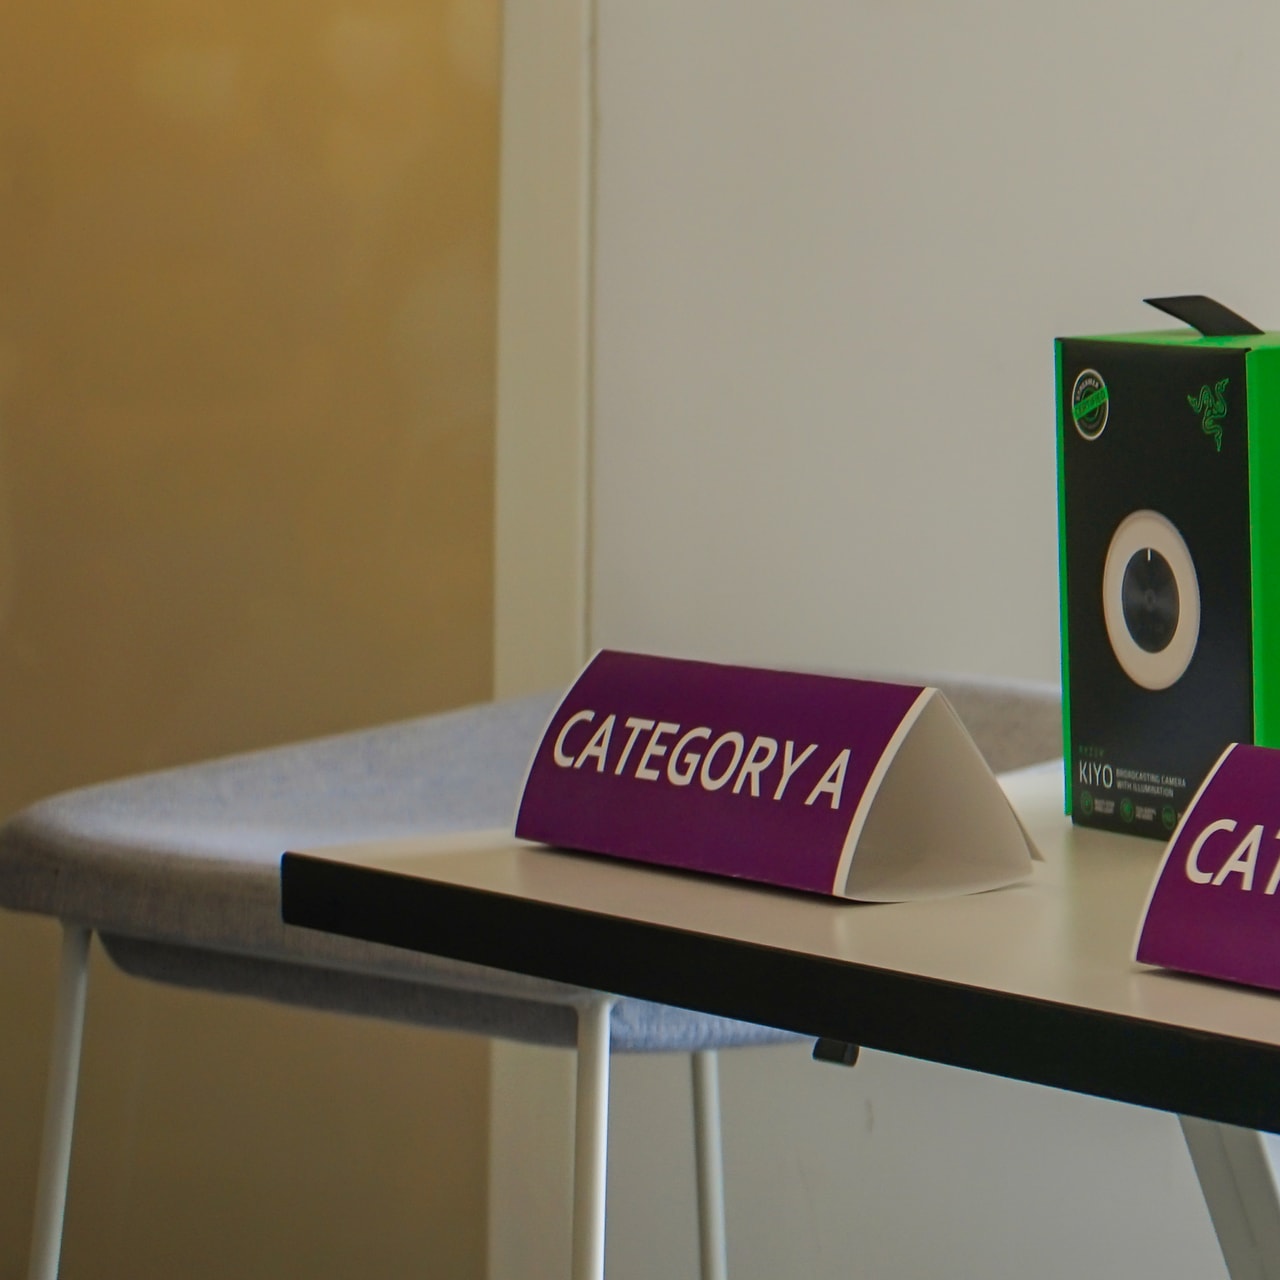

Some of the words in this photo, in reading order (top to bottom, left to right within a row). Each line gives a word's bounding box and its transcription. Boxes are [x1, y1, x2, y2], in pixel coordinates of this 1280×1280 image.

[552, 708, 818, 801] CATEGORY
[804, 748, 852, 810] A
[1079, 759, 1113, 790] KIYO
[1116, 768, 1161, 784] BROADCASTING
[1161, 775, 1186, 788] CAMERA
[1116, 780, 1132, 792] WITH
[1132, 782, 1174, 798] ILLUMINATION
